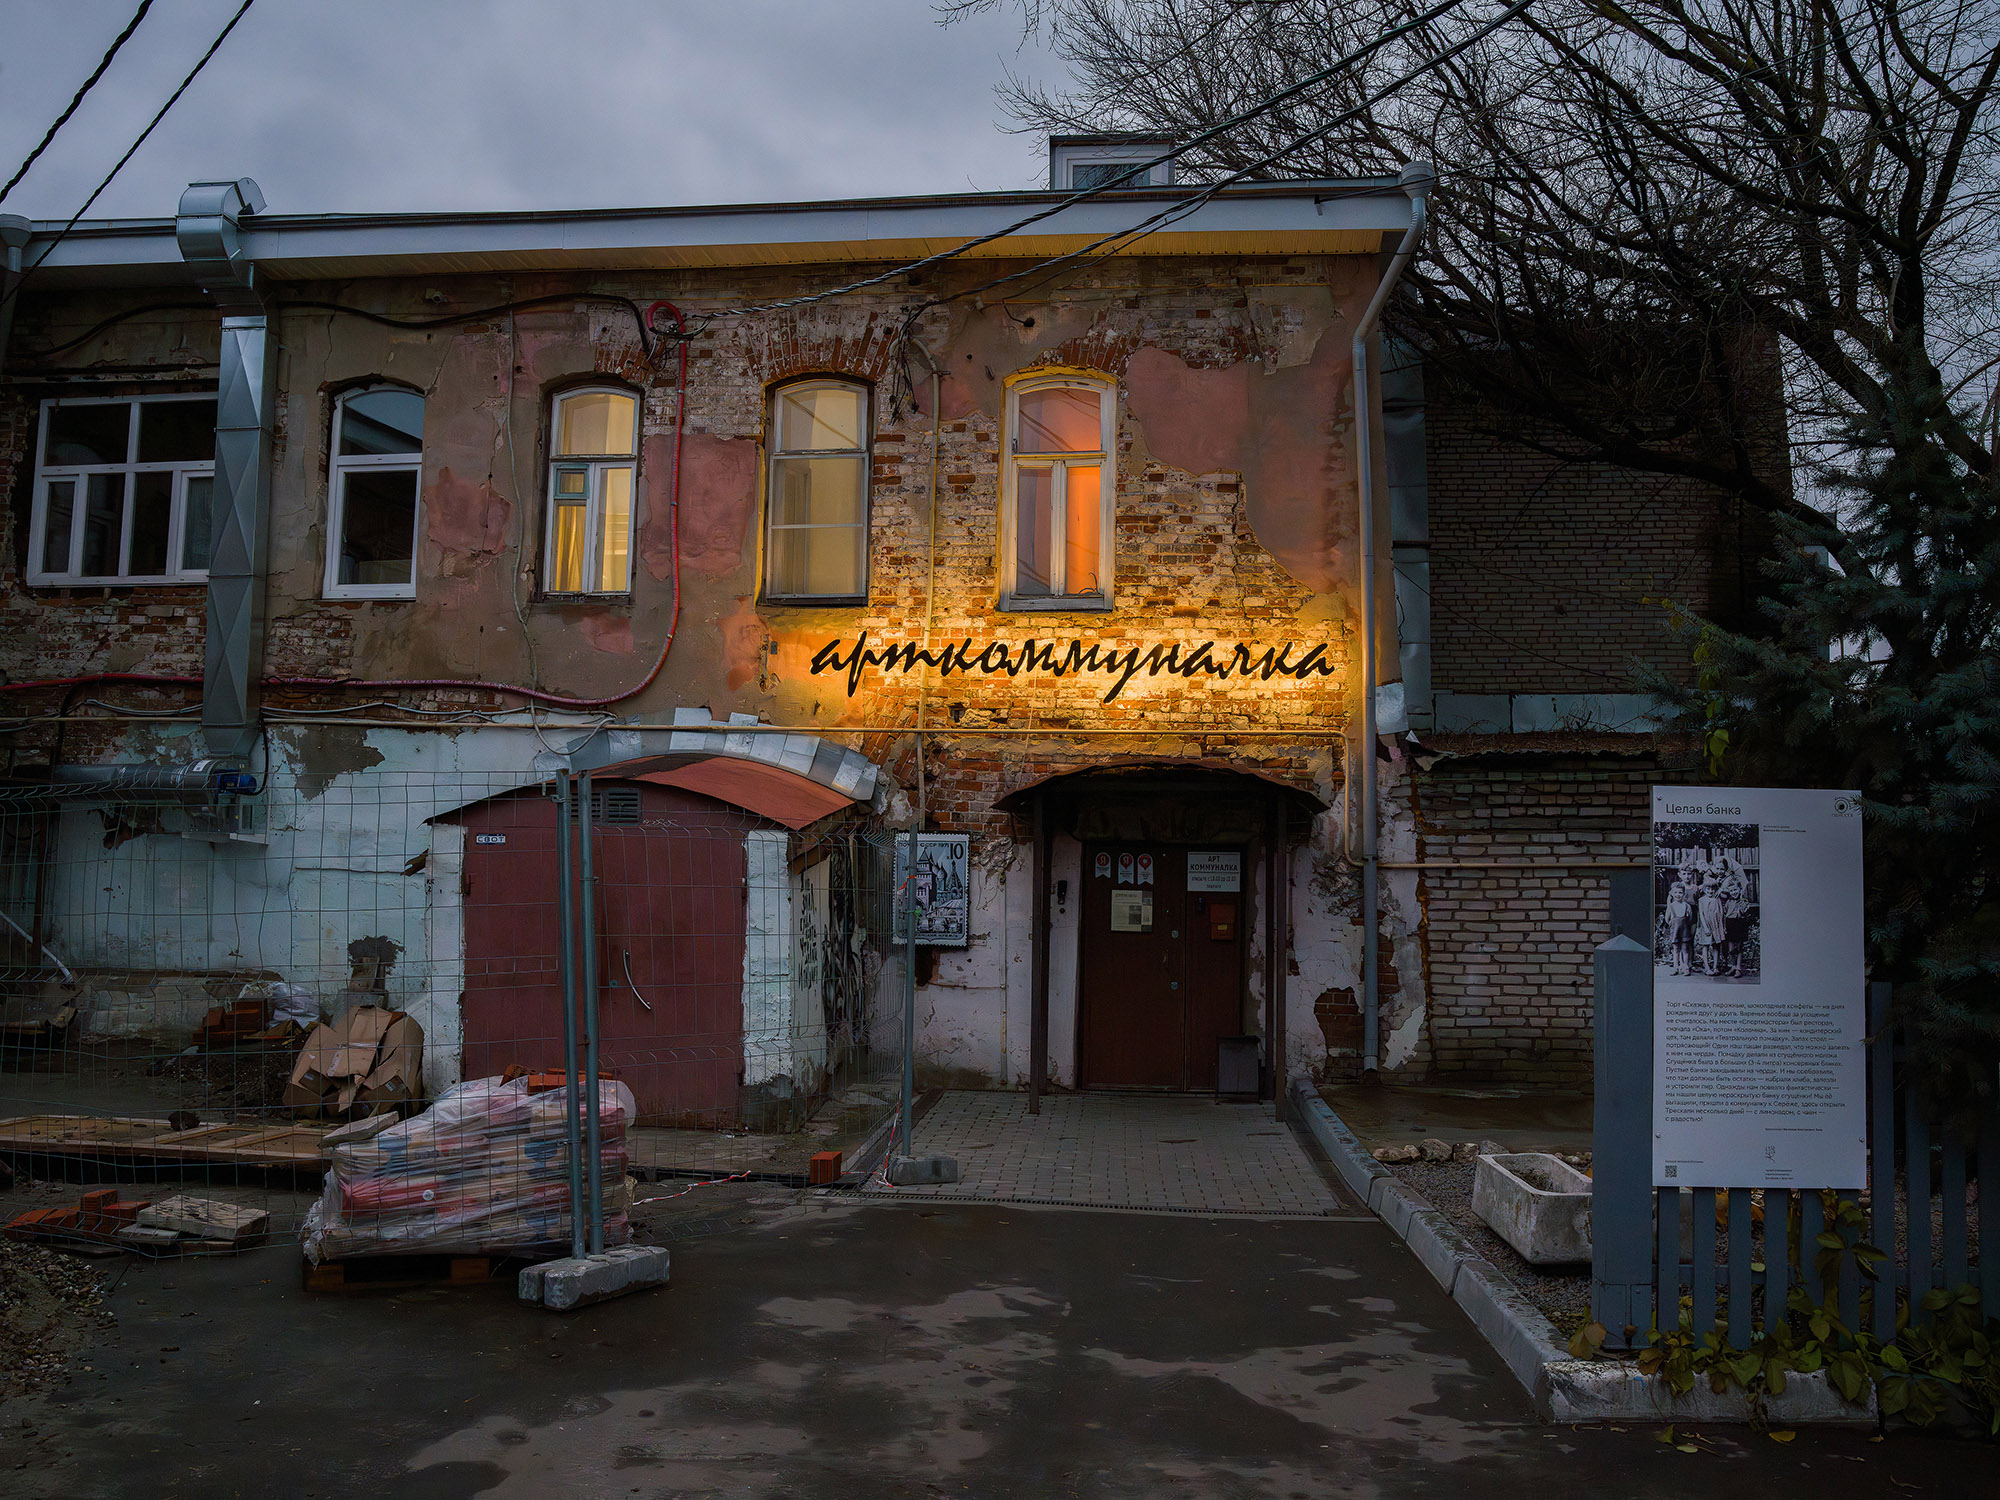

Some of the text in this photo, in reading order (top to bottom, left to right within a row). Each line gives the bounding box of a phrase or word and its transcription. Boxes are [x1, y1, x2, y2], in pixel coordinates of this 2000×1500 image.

[810, 631, 1335, 703] арткоммуналка
[1666, 802, 1741, 815] Целая банка
[950, 843, 964, 860] 10
